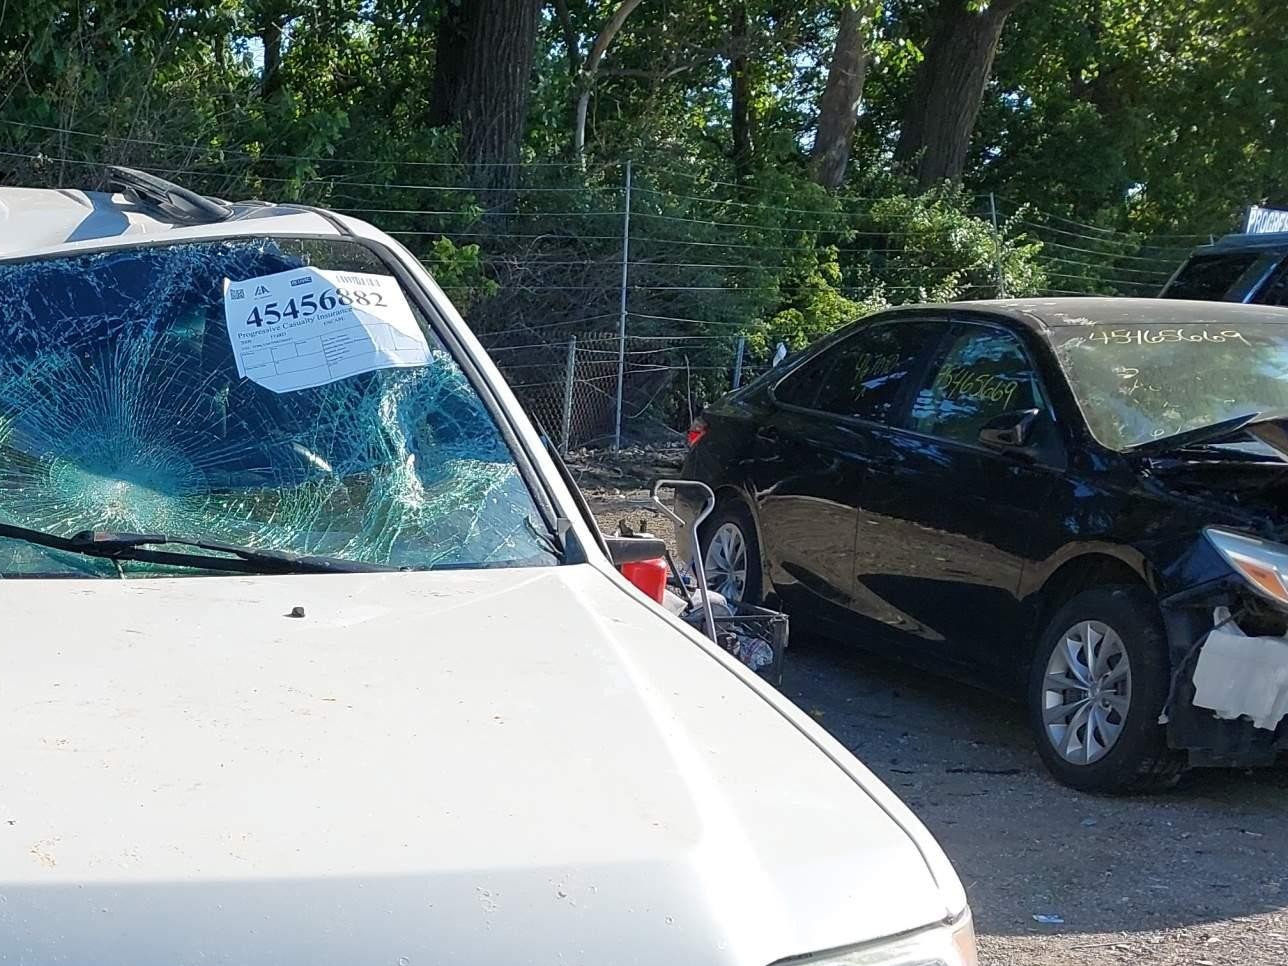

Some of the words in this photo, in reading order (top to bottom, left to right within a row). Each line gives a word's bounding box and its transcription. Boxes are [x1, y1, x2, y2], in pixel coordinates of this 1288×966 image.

[238, 324, 281, 339] Progressive
[282, 316, 315, 330] Casualty
[317, 308, 352, 321] Insurance
[246, 287, 388, 328] 45456882
